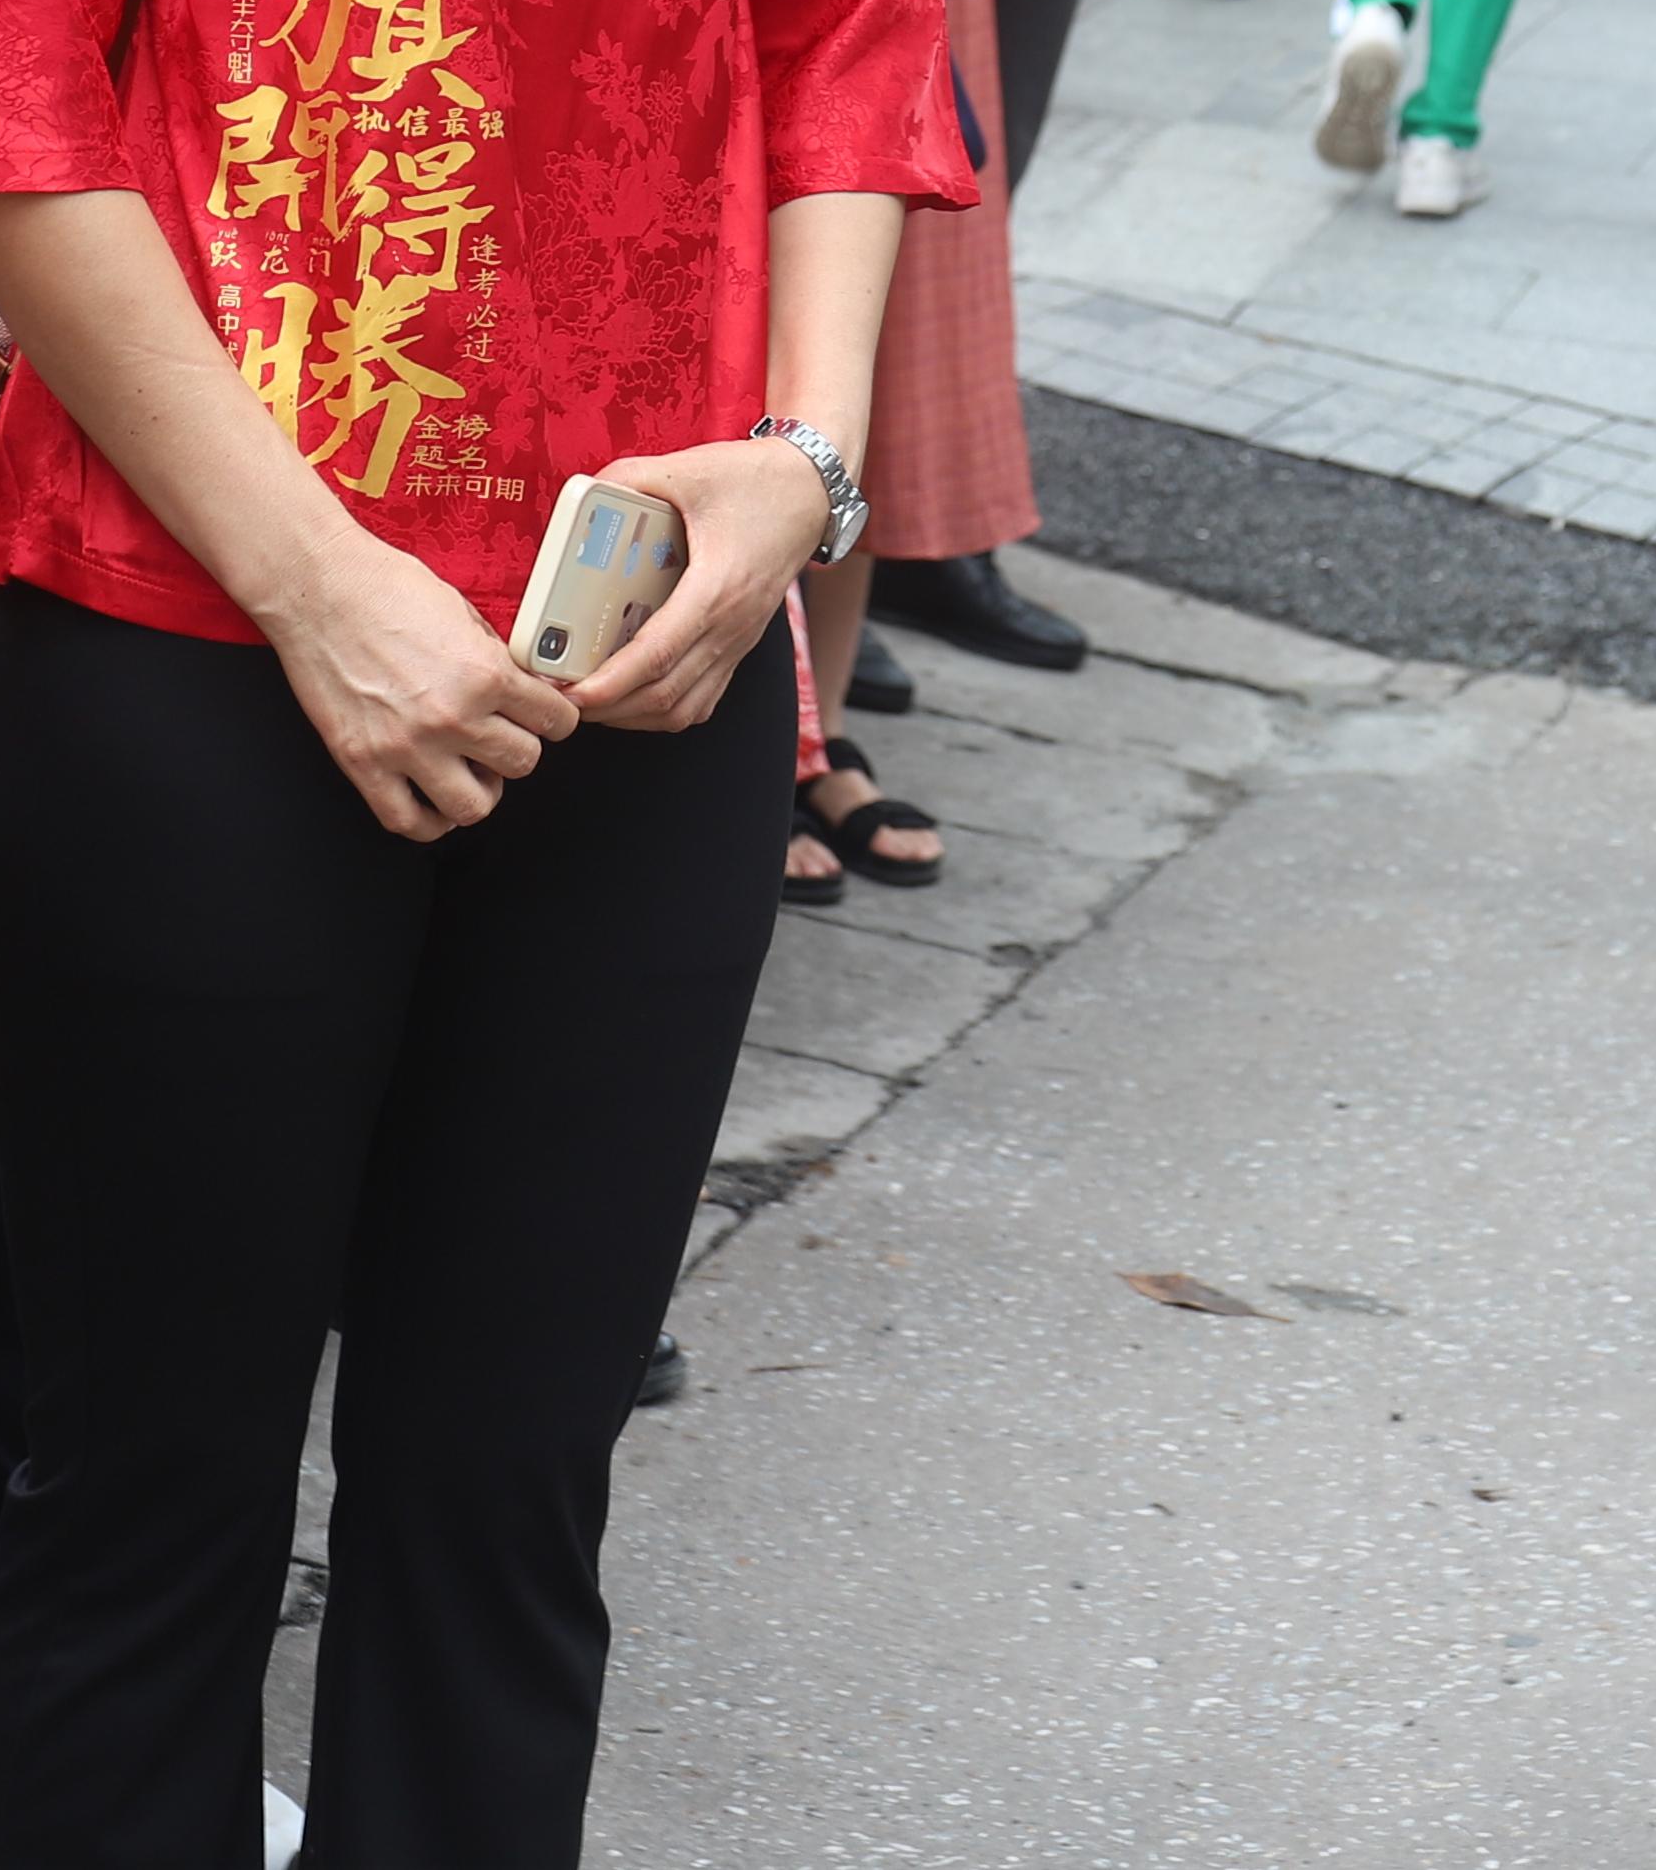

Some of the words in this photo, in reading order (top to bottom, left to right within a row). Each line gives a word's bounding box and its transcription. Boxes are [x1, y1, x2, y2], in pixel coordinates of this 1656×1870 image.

[352, 103, 506, 141] 执信最强
[460, 234, 502, 363] 逢考必过
[414, 414, 492, 441] 金榜
[408, 444, 488, 470] 题名
[405, 475, 525, 502] 未来可期
